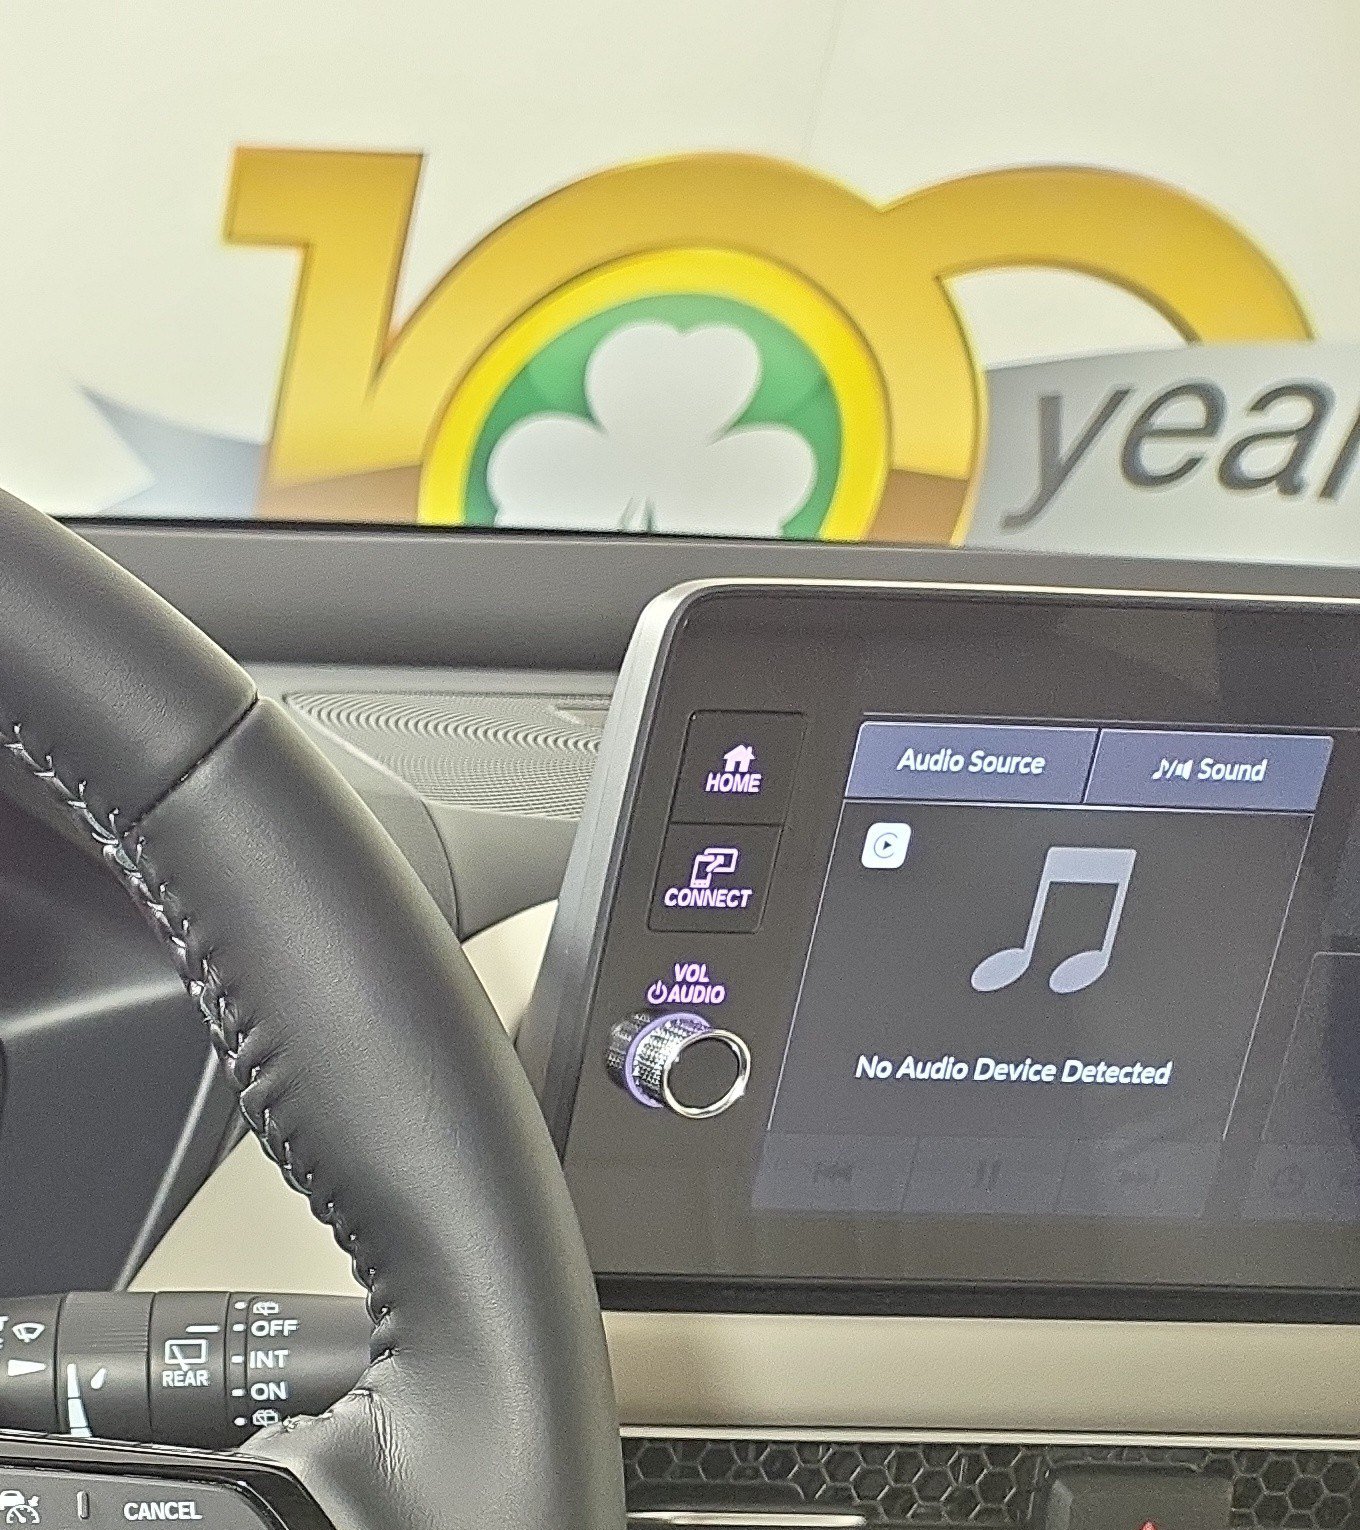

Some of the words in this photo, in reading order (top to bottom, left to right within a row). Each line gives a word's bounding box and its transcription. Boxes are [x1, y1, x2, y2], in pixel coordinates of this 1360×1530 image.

[897, 749, 964, 773] Audio
[968, 750, 1045, 775] Source
[1197, 758, 1267, 782] Sound
[705, 773, 761, 793] HOME
[664, 888, 753, 908] CONNECT
[674, 963, 710, 983] VOL
[667, 985, 726, 1004] AUDIO
[855, 1055, 892, 1079] No
[895, 1055, 968, 1081] Audio
[972, 1056, 1056, 1082] Device
[1061, 1060, 1173, 1085] Detected
[251, 1320, 298, 1337] OFF
[250, 1350, 288, 1368] INT
[162, 1370, 208, 1388] REAR
[250, 1383, 288, 1400] ON
[123, 1501, 203, 1522] CANCEL
